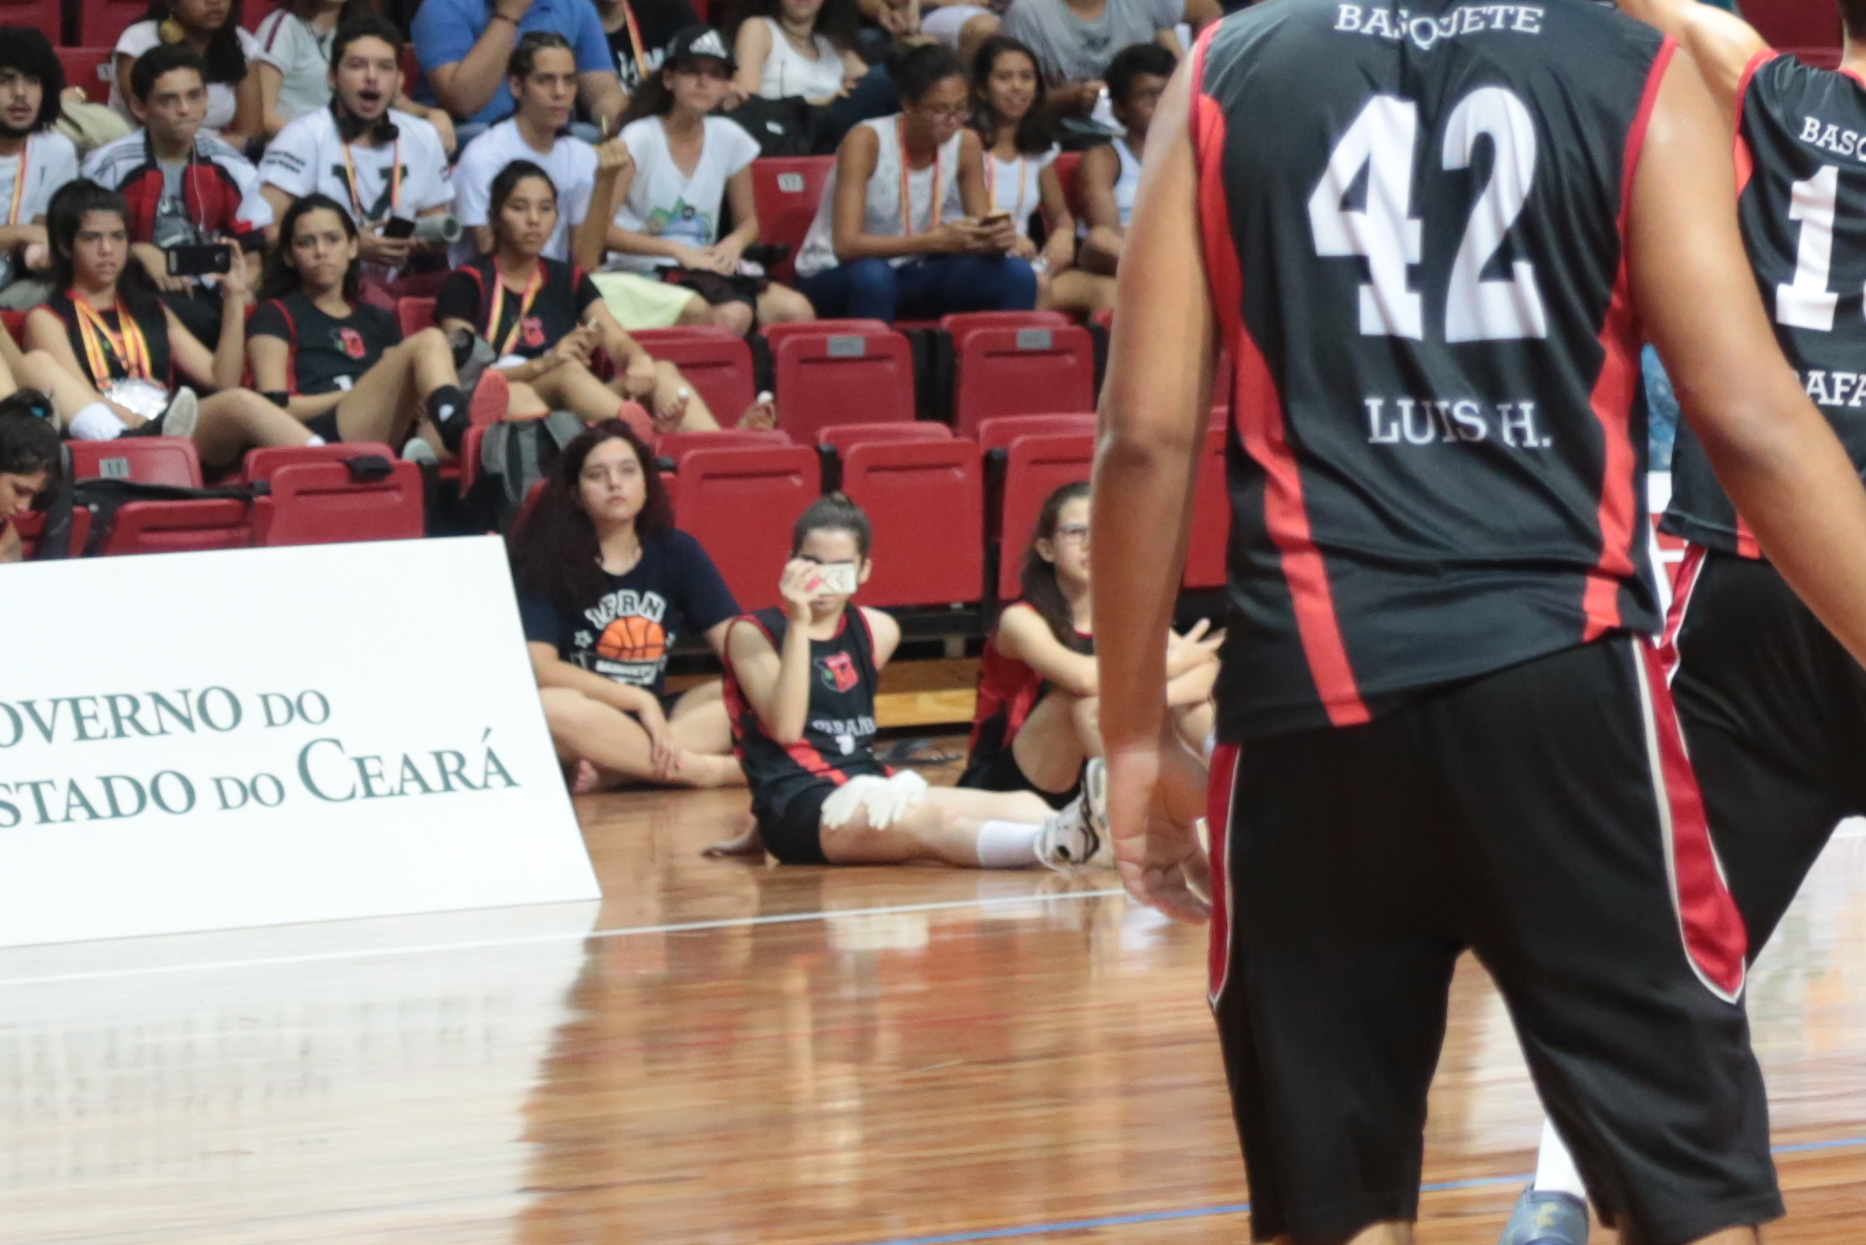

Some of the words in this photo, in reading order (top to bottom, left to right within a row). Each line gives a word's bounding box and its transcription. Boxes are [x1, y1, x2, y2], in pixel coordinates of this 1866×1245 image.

[1334, 3, 1544, 50] BASQUETE
[1308, 87, 1547, 343] 42
[1365, 398, 1488, 444] LUIS
[1497, 402, 1553, 449] H.
